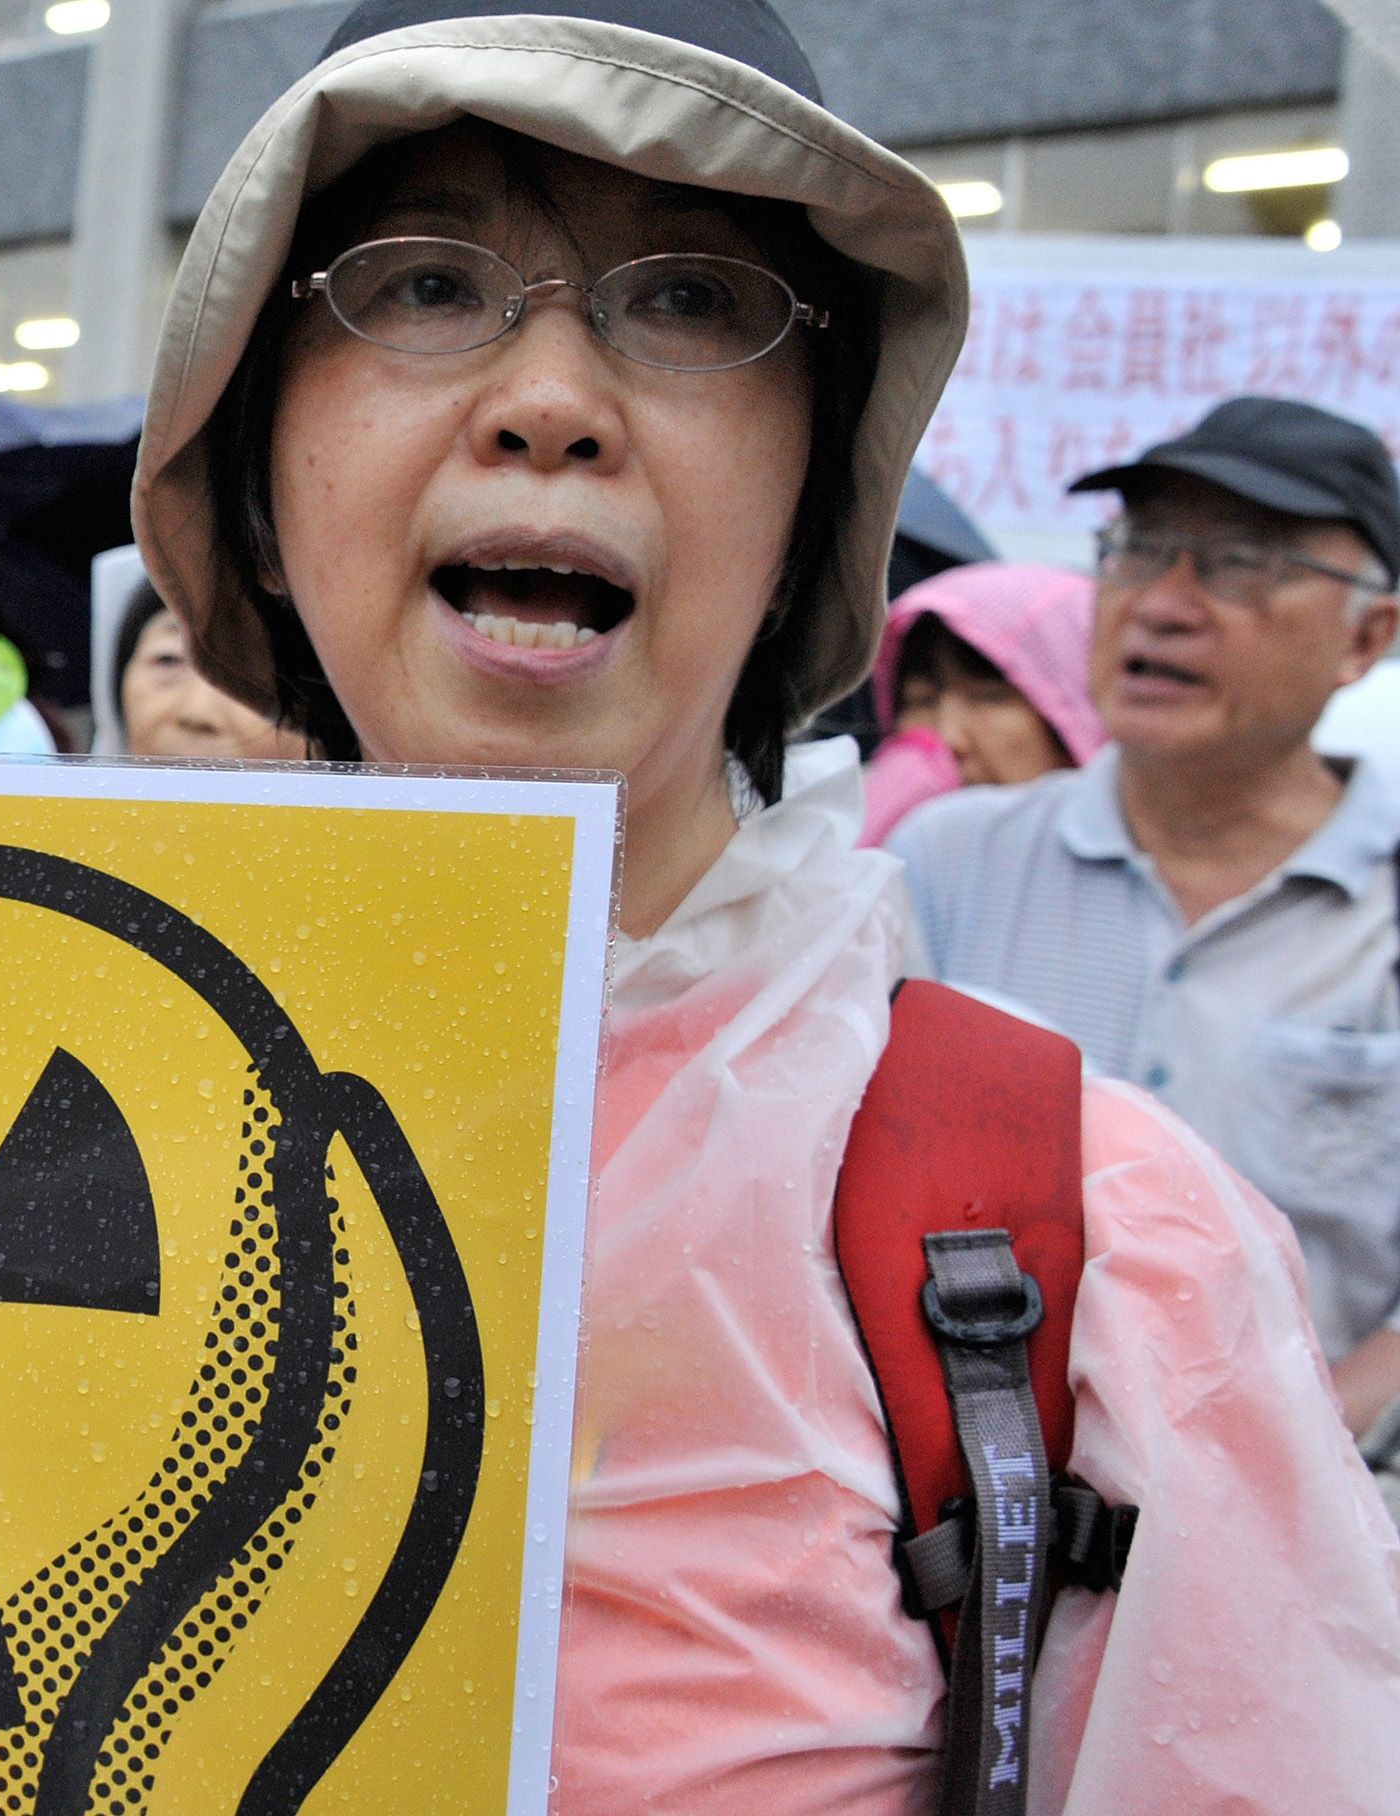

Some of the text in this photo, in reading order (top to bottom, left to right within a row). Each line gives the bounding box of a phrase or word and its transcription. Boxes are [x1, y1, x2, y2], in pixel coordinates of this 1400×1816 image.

[960, 288, 1400, 397] は会員社以外
[982, 1445, 1037, 1790] MILLET
